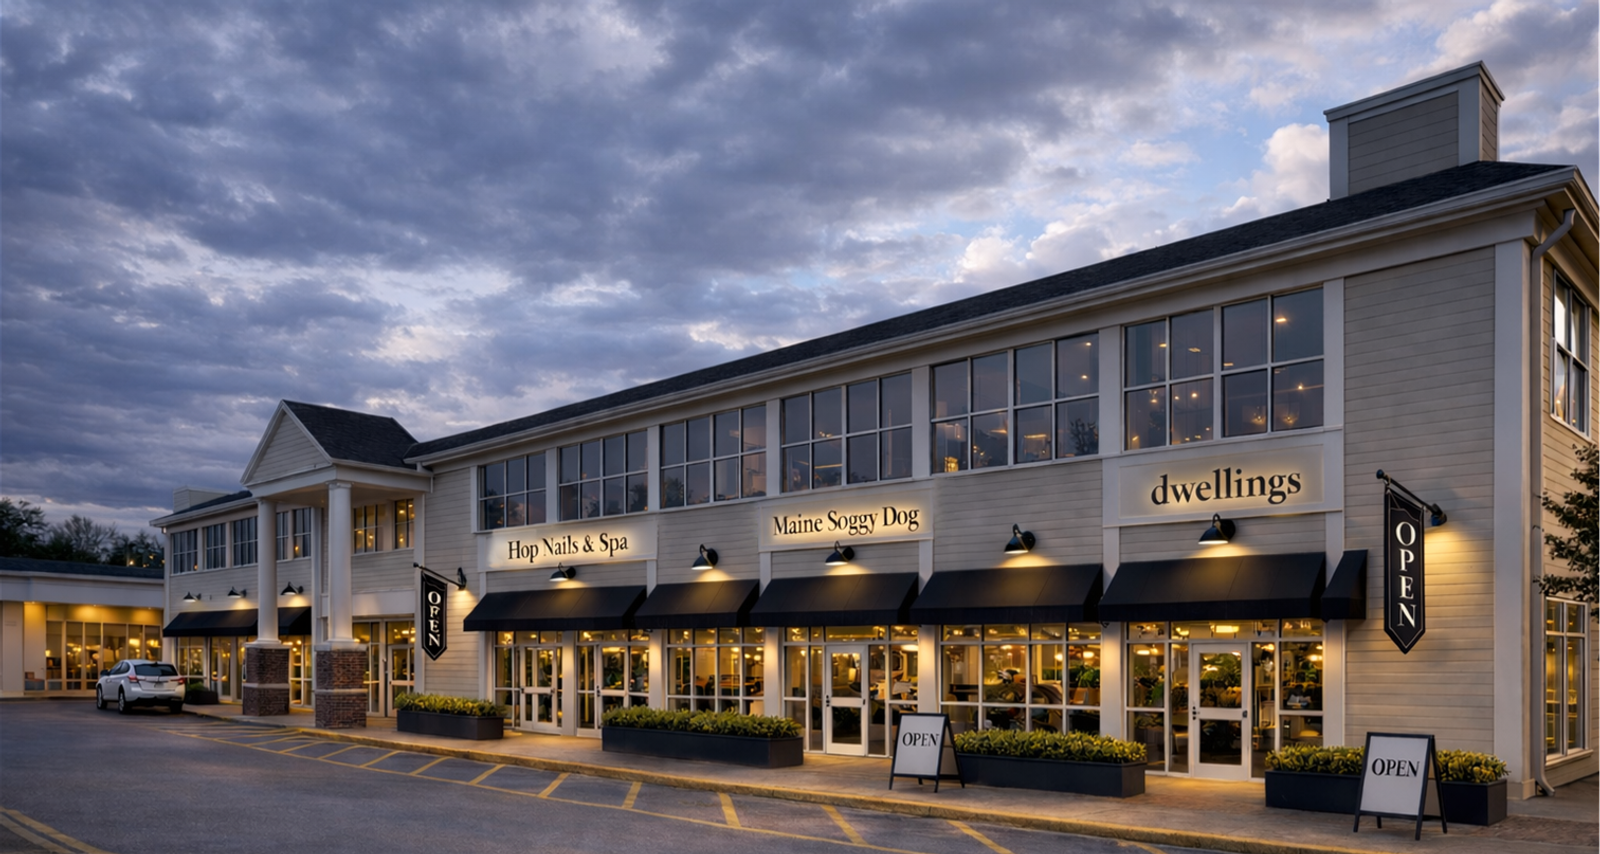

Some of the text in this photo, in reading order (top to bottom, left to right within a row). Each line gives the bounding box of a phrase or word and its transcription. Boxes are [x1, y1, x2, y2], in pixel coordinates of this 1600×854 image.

[1151, 467, 1302, 505] dwellings
[772, 506, 920, 536] Maine Soggy Dog
[508, 532, 629, 563] Hop Nails & Spa
[1395, 521, 1417, 628] OPEN
[902, 731, 940, 747] OPEN
[1371, 757, 1420, 777] OPEN
